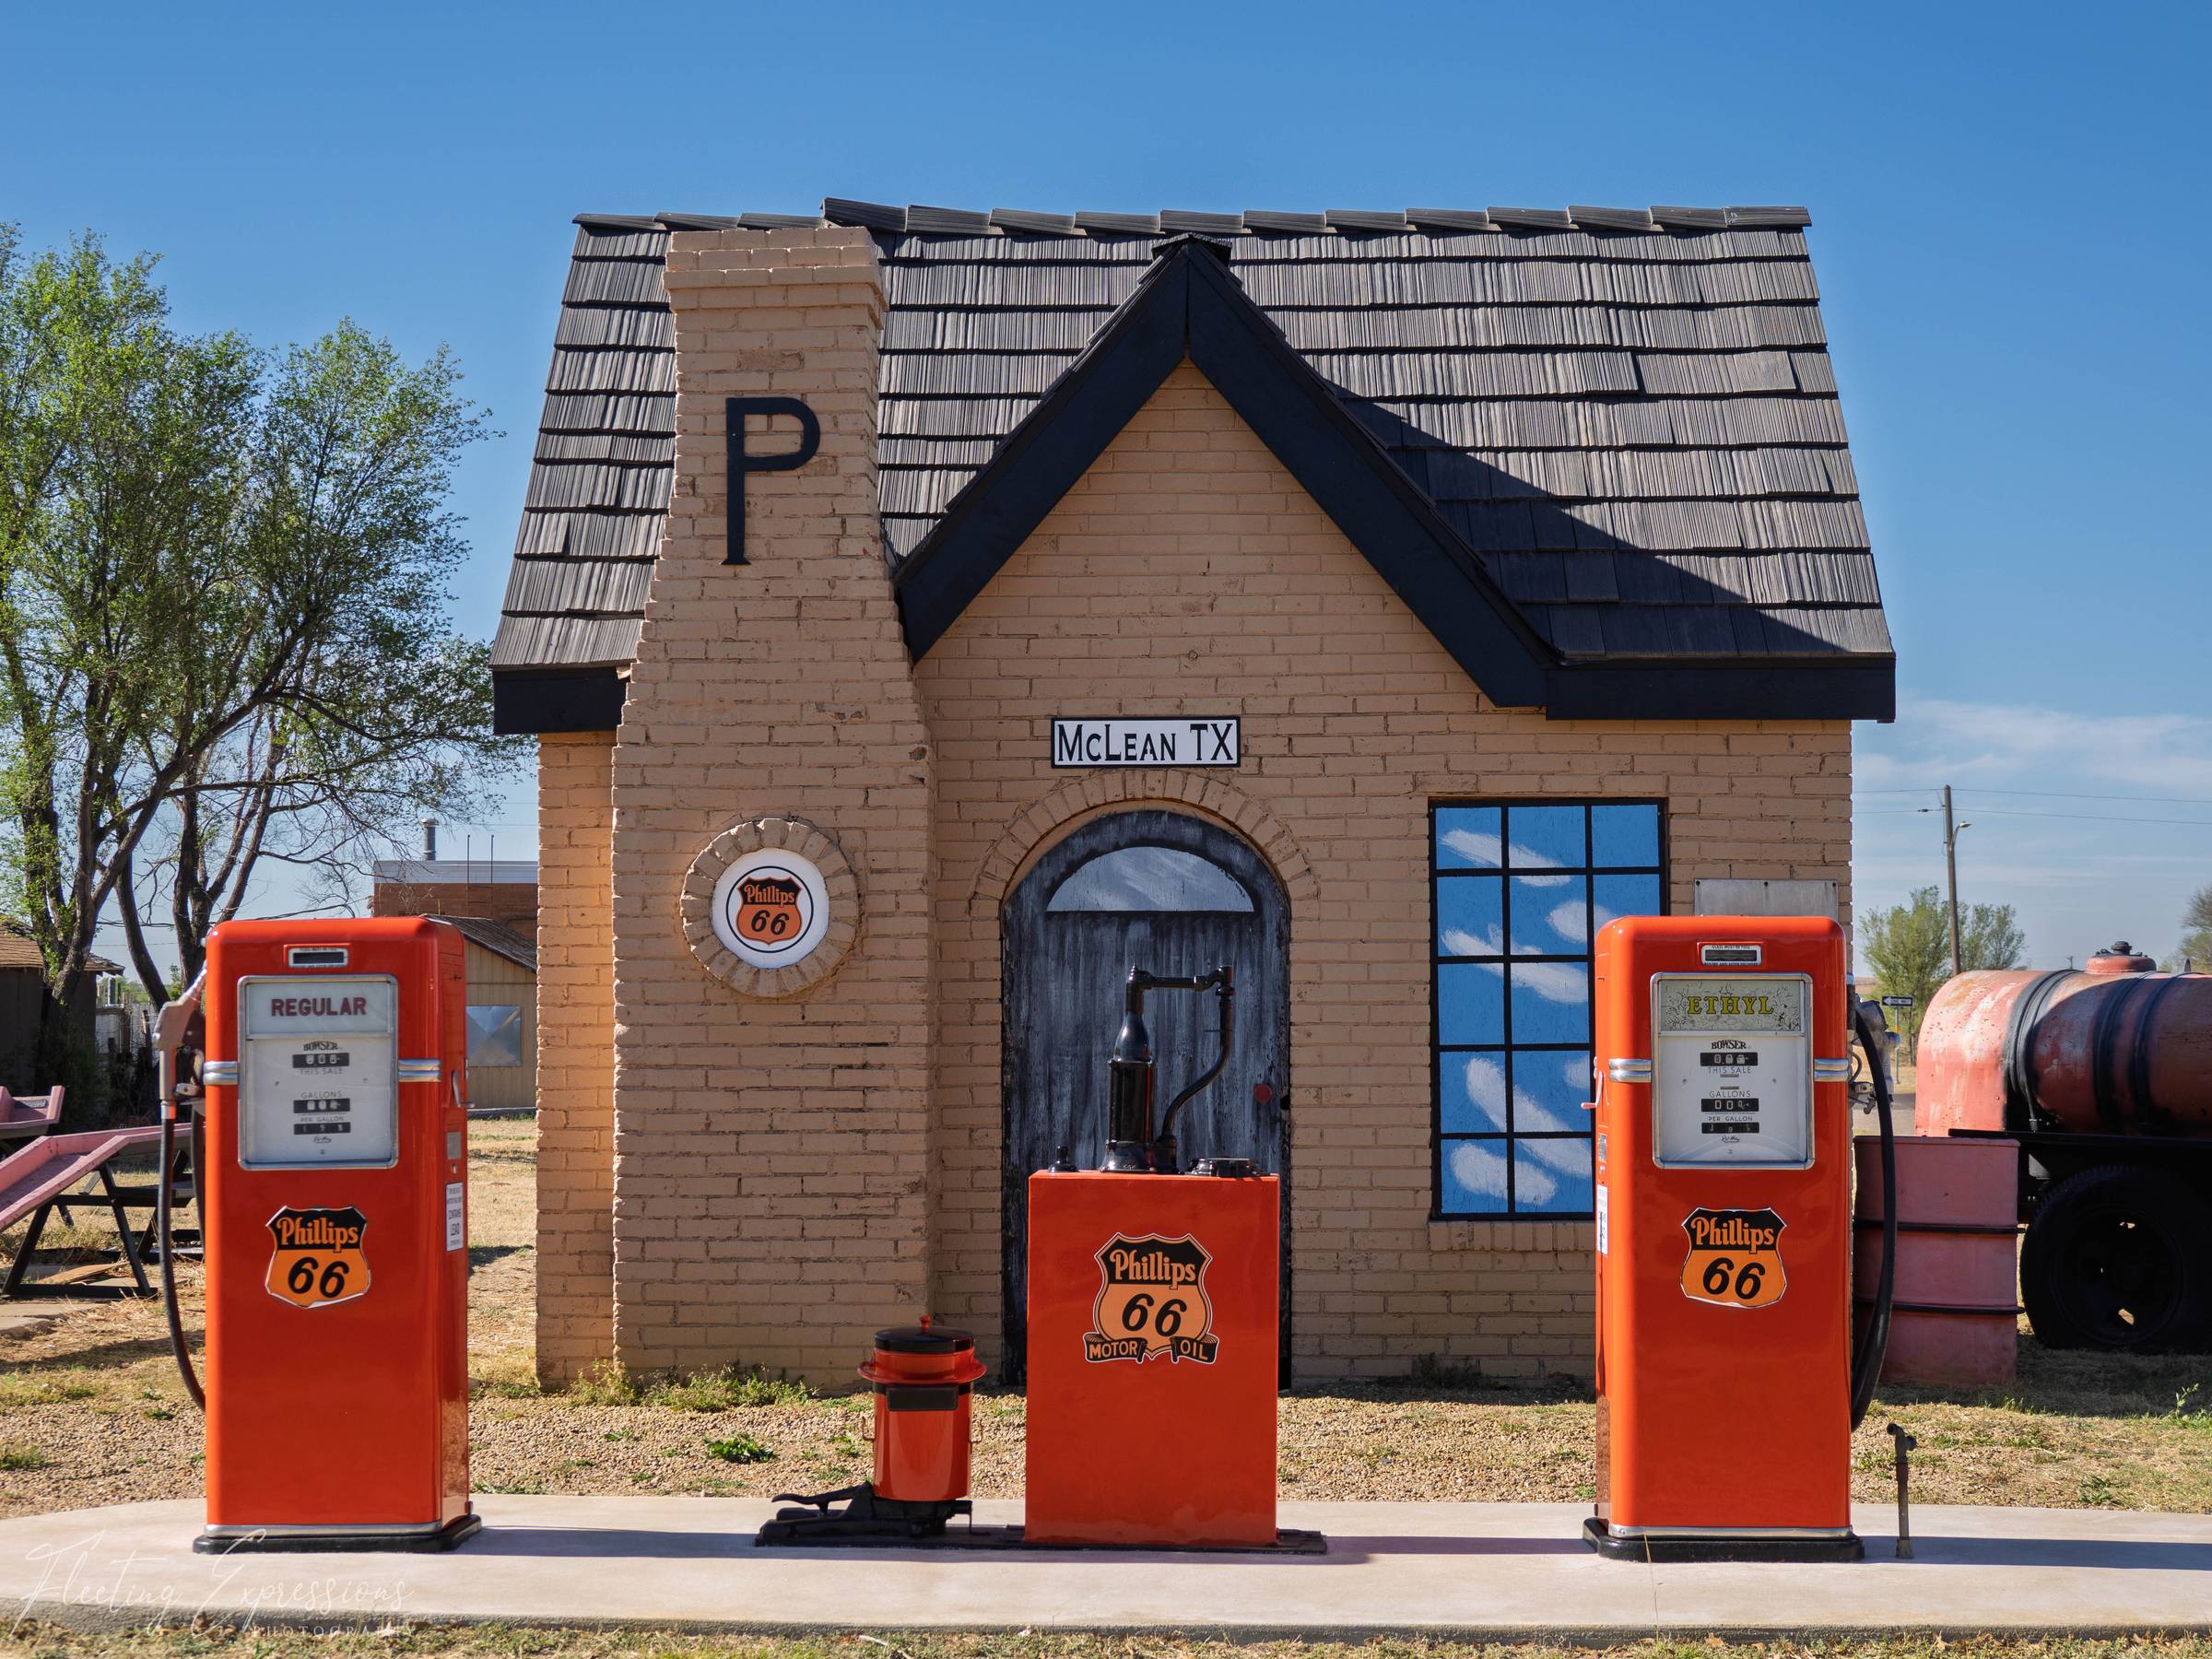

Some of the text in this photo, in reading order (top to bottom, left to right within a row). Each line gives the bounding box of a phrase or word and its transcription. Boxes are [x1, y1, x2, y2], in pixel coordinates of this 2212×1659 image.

[721, 397, 820, 565] P
[1190, 723, 1234, 760] TX
[744, 884, 795, 908] Phillips
[751, 910, 790, 935] 66
[271, 997, 367, 1017] REGULAR
[1688, 995, 1774, 1015] ETHYL
[1712, 1040, 1747, 1050] BOWSER
[300, 1090, 343, 1100] GALLONS
[1709, 1090, 1751, 1099] GALLONS
[276, 1217, 359, 1253] Phillips
[1690, 1217, 1774, 1254] Phillips
[288, 1256, 349, 1299] 66
[1109, 1248, 1196, 1289] Phillips
[1702, 1257, 1766, 1300] 66
[1122, 1293, 1187, 1337] 66
[1088, 1340, 1209, 1360] MOTOR OIL
